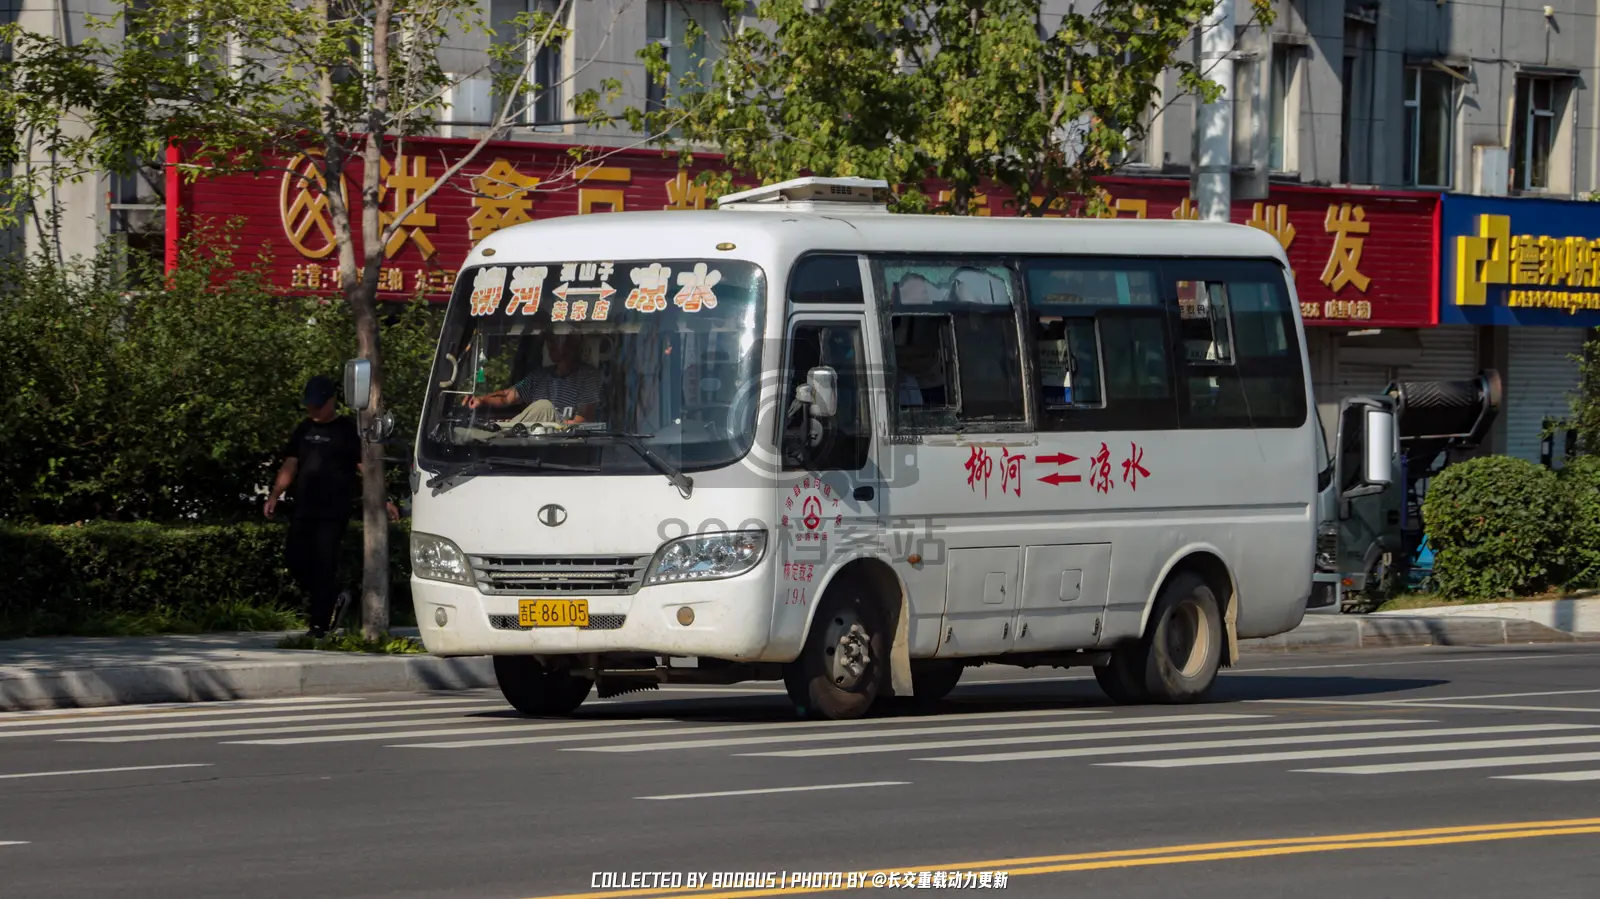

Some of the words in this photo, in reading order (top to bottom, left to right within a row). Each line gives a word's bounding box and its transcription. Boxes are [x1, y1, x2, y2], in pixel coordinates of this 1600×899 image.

[1509, 234, 1600, 287] 德邦快
[625, 262, 722, 313] 凉水
[964, 443, 1027, 500] 柳河
[1089, 441, 1151, 495] 凉水
